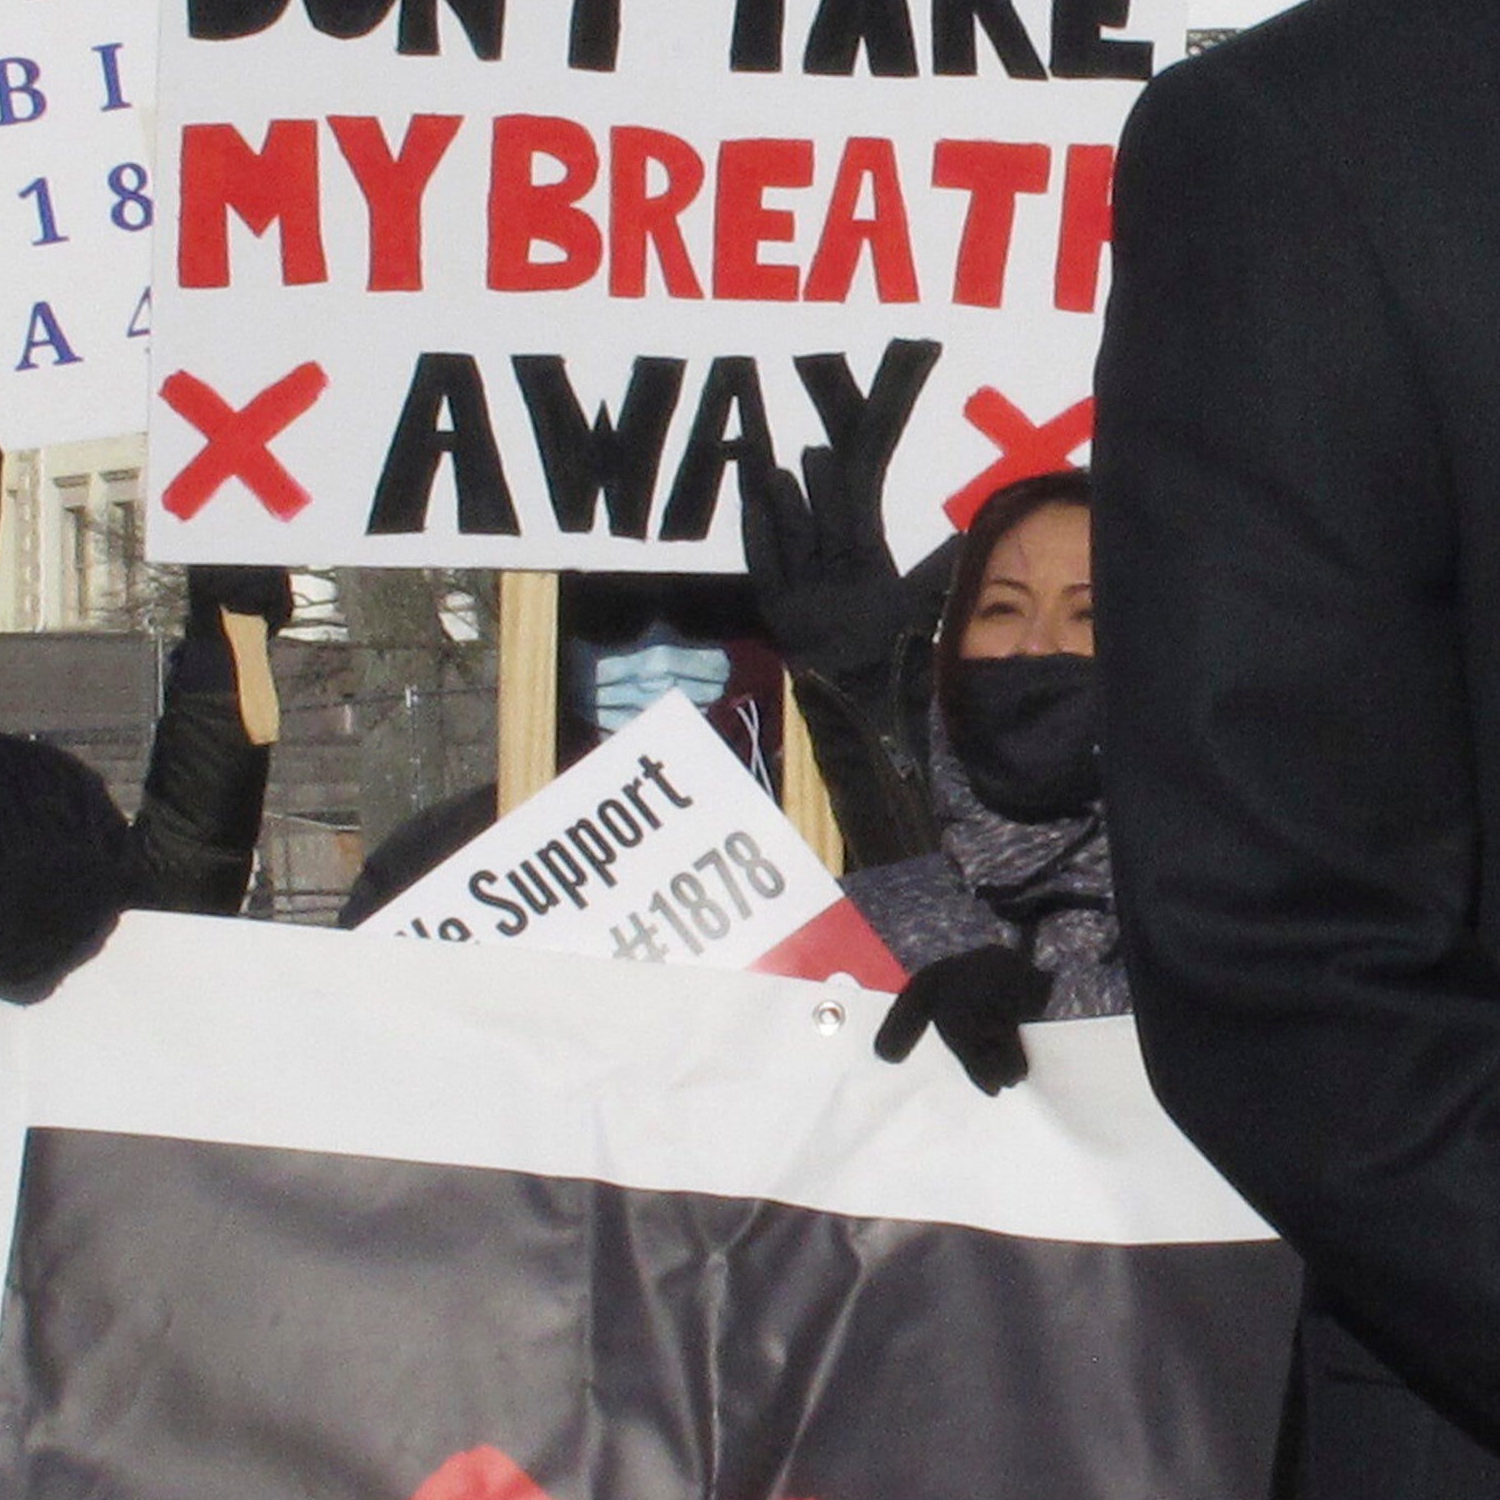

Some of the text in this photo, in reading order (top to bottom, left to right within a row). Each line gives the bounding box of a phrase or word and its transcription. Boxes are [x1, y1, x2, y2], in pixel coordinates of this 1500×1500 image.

[177, 114, 464, 292] MY
[365, 338, 944, 541] AWAY
[467, 753, 693, 937] Support
